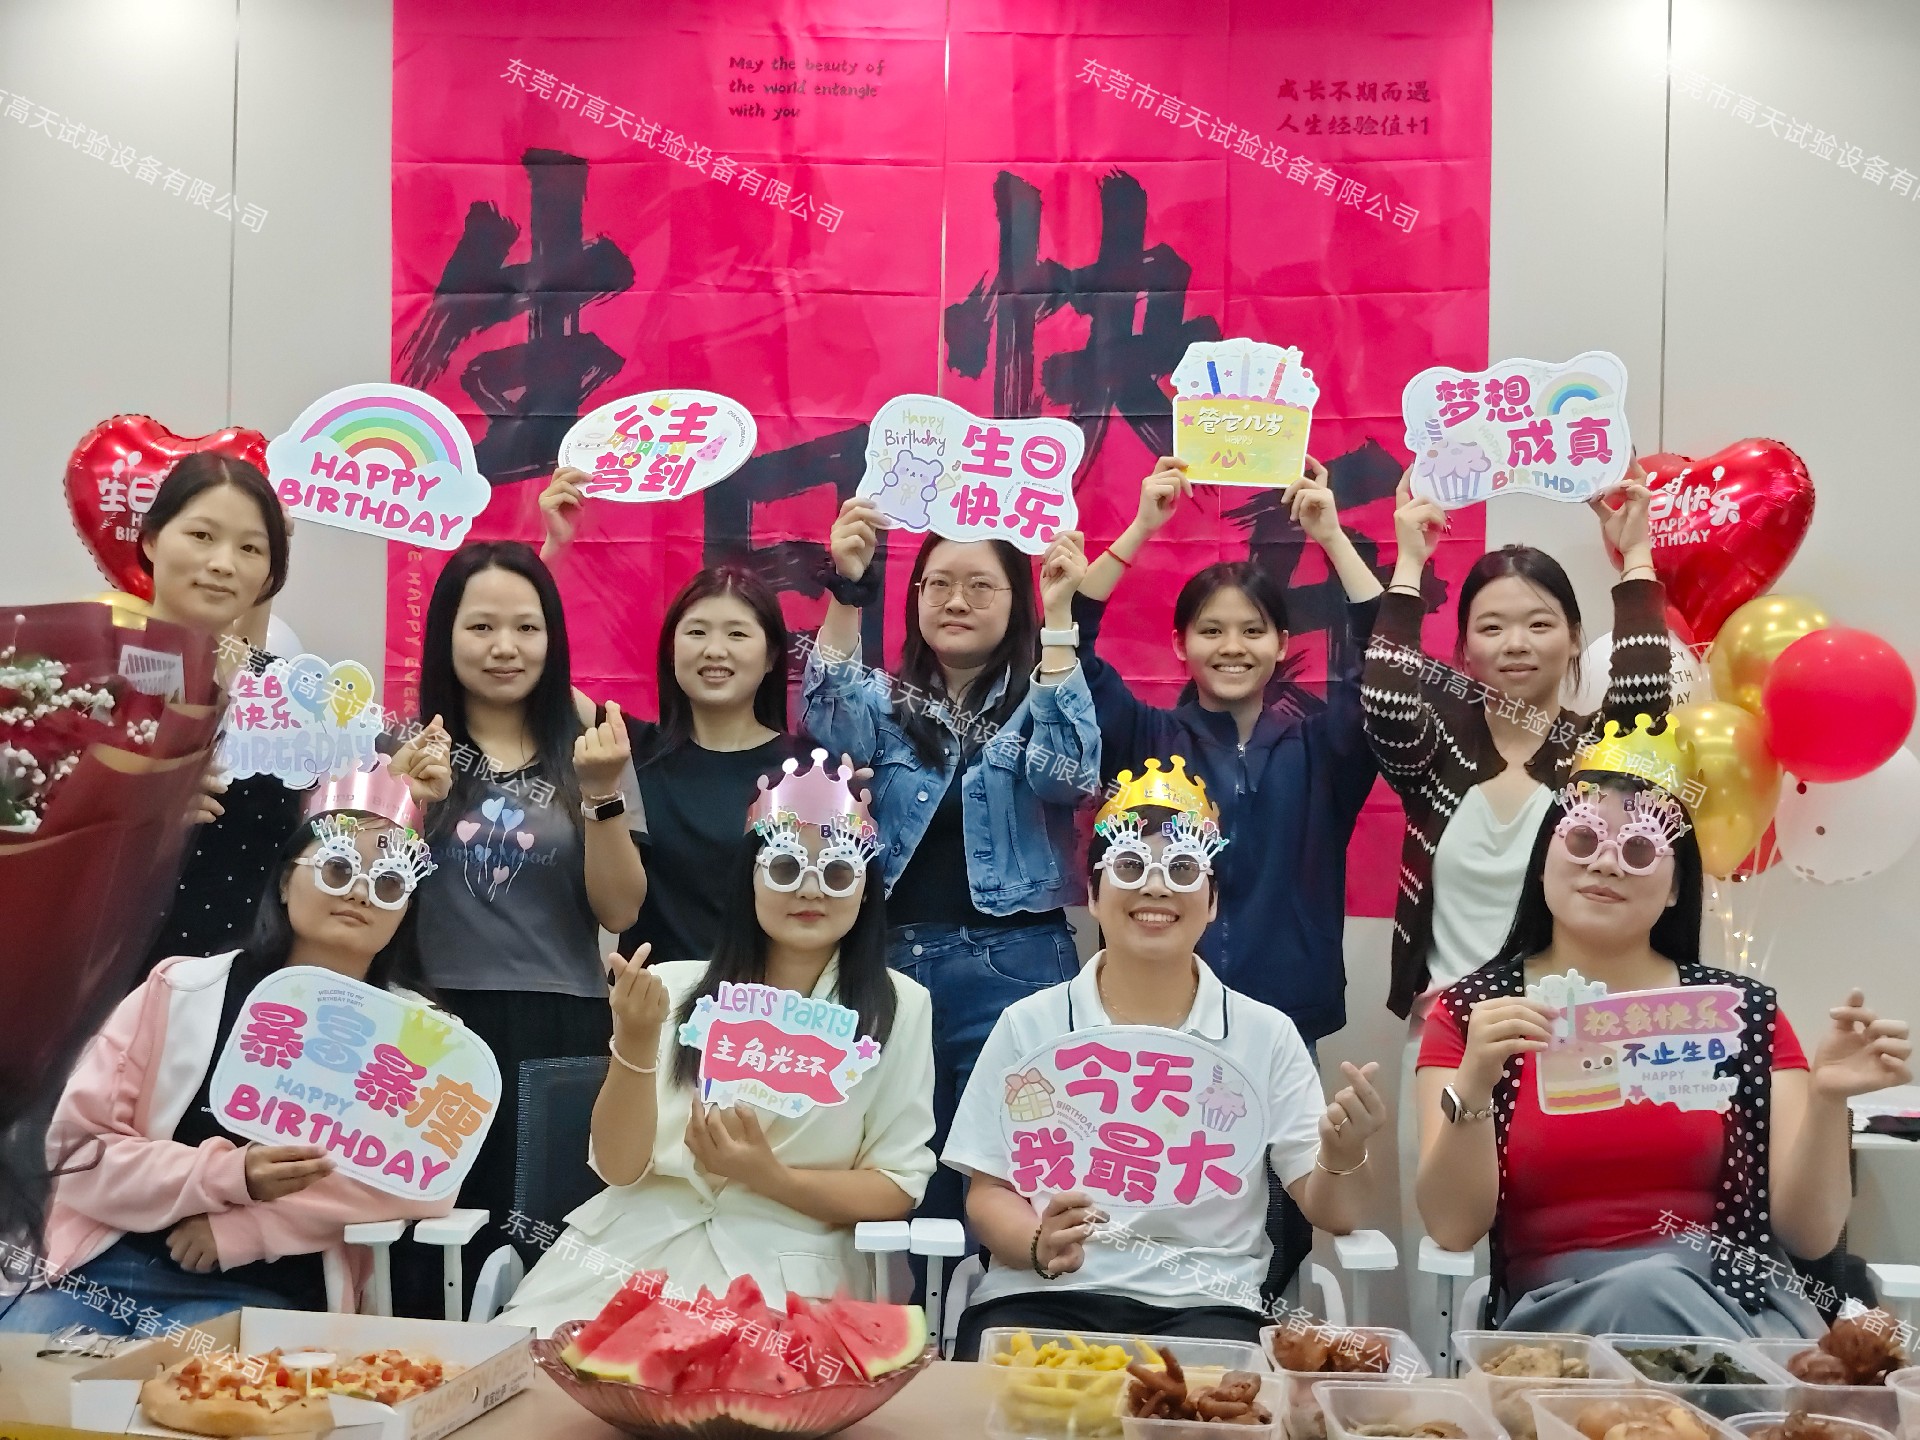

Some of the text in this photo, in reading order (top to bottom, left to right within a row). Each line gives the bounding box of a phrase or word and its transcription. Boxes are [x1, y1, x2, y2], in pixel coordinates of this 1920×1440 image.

[729, 56, 885, 76] May the beauty of
[729, 79, 878, 99] the world entangle
[1277, 79, 1432, 103] 成长不期而遇
[728, 103, 800, 121] with you
[1276, 114, 1429, 136] 人生经验值+1
[1435, 375, 1534, 428] 梦想
[614, 402, 718, 444] 公主
[902, 408, 944, 435] Happy
[1198, 407, 1284, 436] 管它几岁
[611, 434, 682, 452] HAPPY
[885, 429, 946, 456] Birthday
[962, 425, 1067, 479] 生日
[1507, 417, 1613, 467] 成真
[310, 451, 441, 501] HAPPY
[586, 452, 697, 496] 驾到
[1492, 469, 1606, 494] BIRTHDAY
[100, 476, 158, 513] 生日
[277, 478, 464, 540] BIRTHDAY
[1649, 483, 1740, 526] 日快乐
[950, 481, 1065, 543] 快乐
[1651, 529, 1711, 549] RTHDAY
[237, 675, 283, 698] 生日
[235, 697, 302, 731] 快乐
[1094, 811, 1148, 837] HAPPY
[712, 1035, 828, 1077] 主角光环
[1622, 1038, 1726, 1067] 不止生日
[1054, 1041, 1194, 1117] 今天
[1642, 1070, 1685, 1081] HAPPY
[1668, 1082, 1736, 1095] BIRTHDAY
[274, 1074, 354, 1116] HAPPY
[736, 1082, 788, 1109] HAPPY
[1056, 1100, 1098, 1133] BIRTHDAY
[225, 1083, 450, 1190] BIRTHDAY
[1011, 1121, 1243, 1205] 我最大
